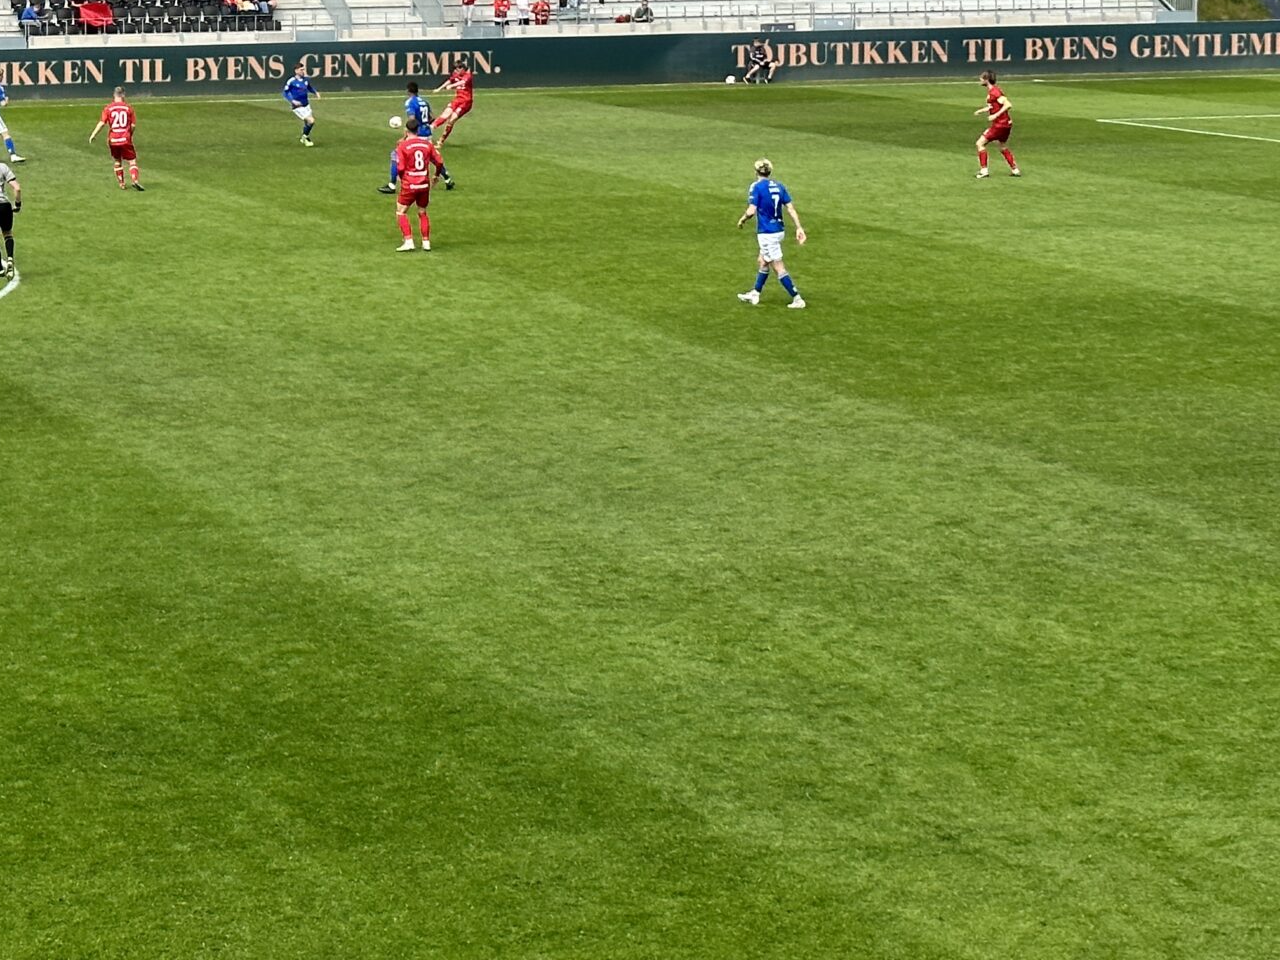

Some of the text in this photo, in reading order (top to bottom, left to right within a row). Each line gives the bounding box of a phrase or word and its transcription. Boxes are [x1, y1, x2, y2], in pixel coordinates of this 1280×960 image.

[962, 38, 1011, 62] TIL
[1025, 36, 1117, 61] BYENS
[119, 58, 172, 83] TIL
[185, 55, 285, 82] BYENS
[110, 110, 128, 129] 20
[414, 150, 425, 170] 8
[771, 194, 780, 217] 7
